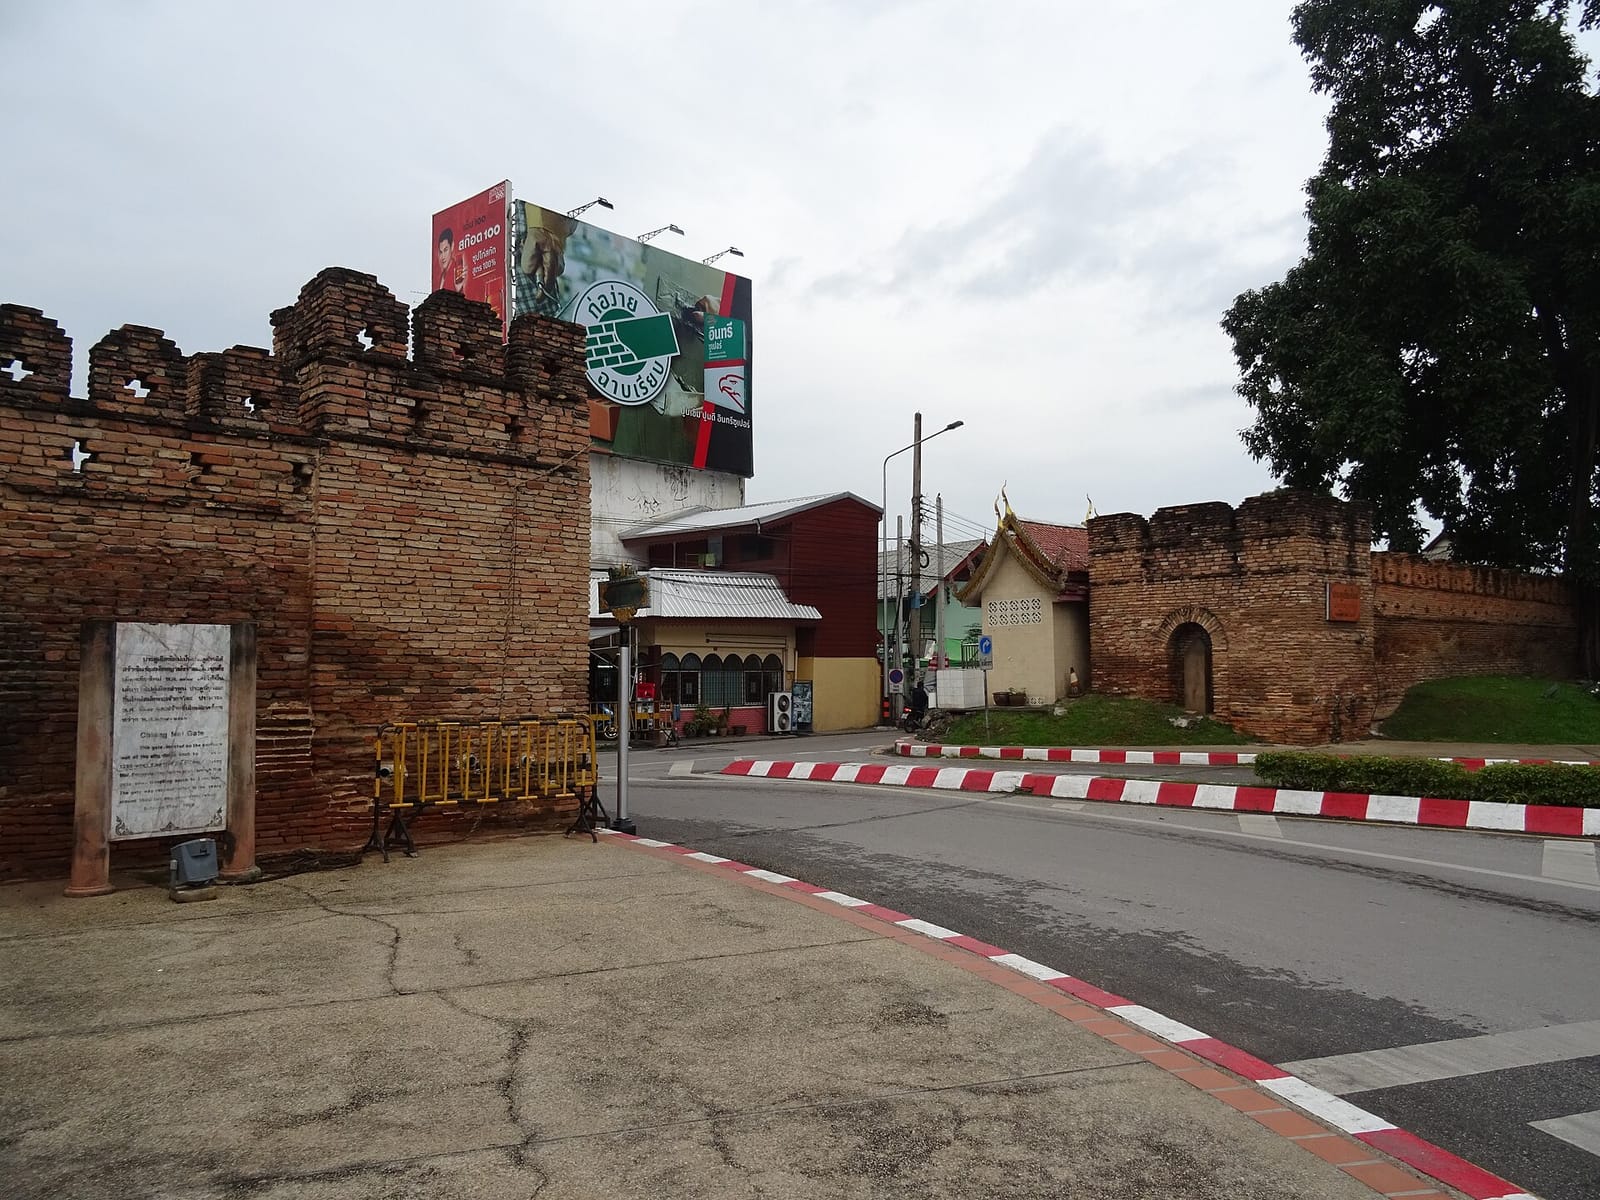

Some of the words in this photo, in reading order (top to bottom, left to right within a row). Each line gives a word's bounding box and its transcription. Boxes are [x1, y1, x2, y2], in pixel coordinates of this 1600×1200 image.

[484, 224, 501, 240] 100
[587, 284, 638, 319] ก่อง่าย
[708, 321, 733, 341] อินทรี
[598, 360, 664, 399] ฉาบเรียบ
